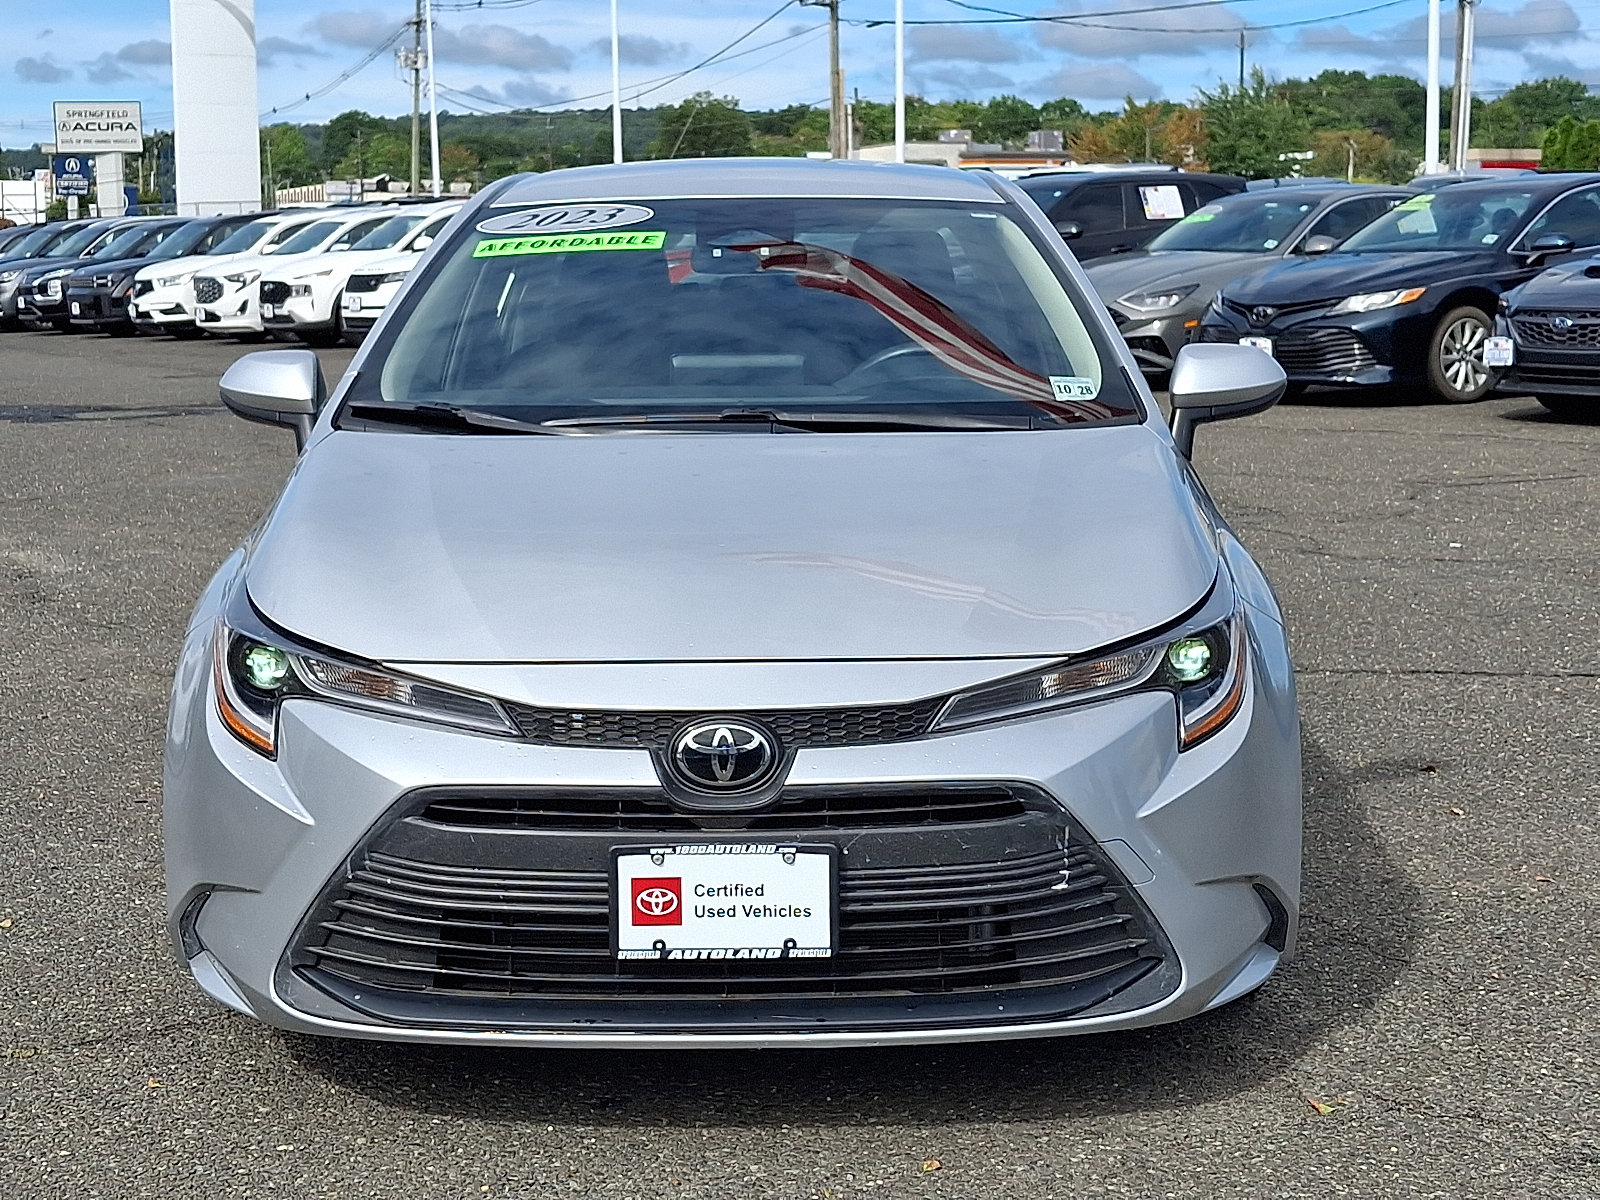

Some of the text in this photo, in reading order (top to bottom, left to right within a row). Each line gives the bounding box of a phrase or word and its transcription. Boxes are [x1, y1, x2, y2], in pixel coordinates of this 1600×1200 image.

[66, 110, 128, 118] SPRINGFIELD
[72, 122, 137, 131] ACURA
[504, 207, 626, 230] 2023
[480, 235, 659, 252] AFFORDABLE
[1057, 385, 1093, 395] 10 28
[694, 883, 765, 897] Certified
[694, 903, 812, 918] Used Vehicles
[667, 948, 782, 960] AUTOLAND
